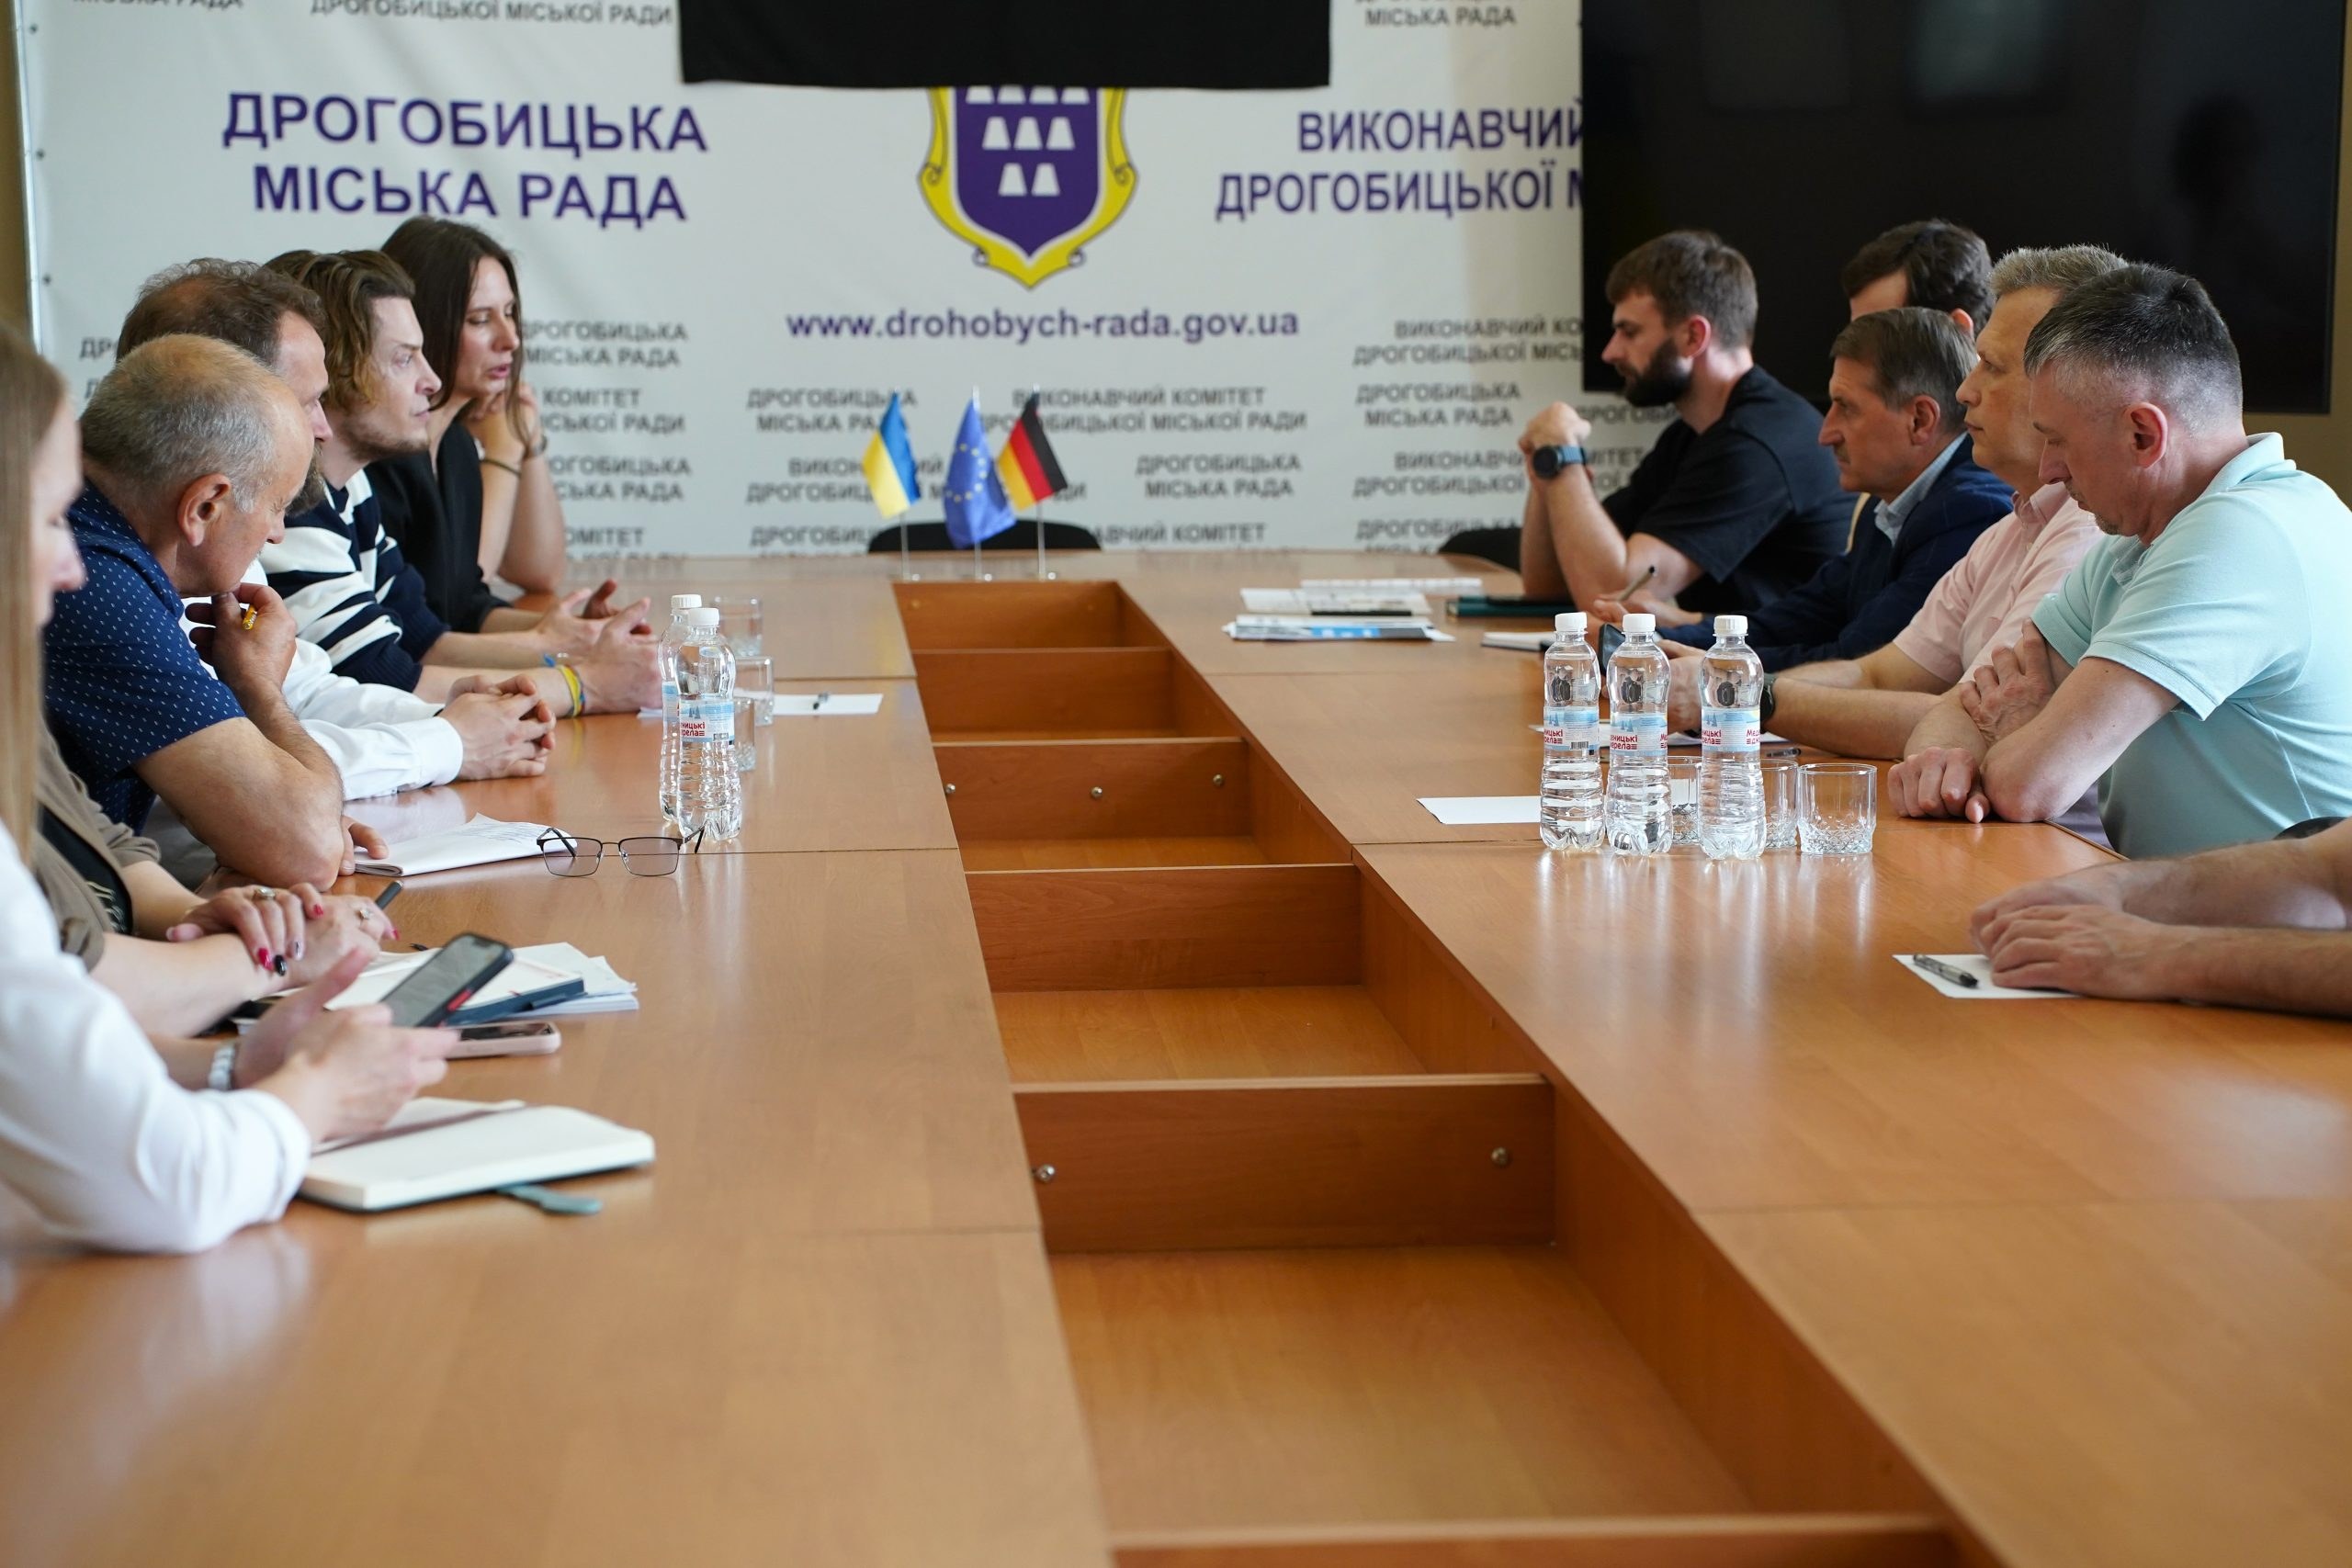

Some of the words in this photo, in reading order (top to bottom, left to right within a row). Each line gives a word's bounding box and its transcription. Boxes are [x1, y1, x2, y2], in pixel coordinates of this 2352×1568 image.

[505, 2, 602, 24] МІСЬКОЇ
[609, 6, 673, 27] РАДИ
[1365, 7, 1450, 27] МІСЬКА
[1455, 6, 1517, 27] РАДА
[223, 93, 707, 158] ДРОГОБИЦЬКА
[254, 164, 497, 218] МІСЬКА
[518, 174, 687, 230] РАДА
[1216, 159, 1558, 220] ДРОГОБИЦЬКОЇ
[786, 309, 1299, 345] www.drohobych-rada.gov.ua
[1395, 314, 1547, 339] ВИКОНАВЧИЙ
[617, 348, 681, 368] РАДА
[1352, 340, 1525, 367] ДРОГОБИЦЬКОЇ
[542, 388, 640, 408] КОМІТЕТ
[746, 389, 917, 410] ДРОГОБИЦЬА
[1012, 387, 1164, 408] ВКОНАВЧИЙ
[1171, 387, 1266, 407] КОМІТЕТ
[1355, 382, 1521, 406] ДРОГОБИЦЬКА
[623, 413, 684, 434] РАДИ
[756, 413, 842, 433] МІСЬКА
[1152, 412, 1242, 433] МІСЬКОЇ
[1248, 412, 1307, 432] РАДИ
[1364, 409, 1448, 428] МІСЬКА
[1453, 406, 1513, 427] РАДА
[1135, 455, 1302, 477] ДРОГОБИЦЬКА
[1395, 449, 1523, 470] ВИКОНАВЧИ
[621, 482, 684, 502] РАДА
[1144, 479, 1229, 499] МІСЬКА
[1234, 479, 1295, 500] РАДА
[1171, 523, 1267, 544] КОМІТЕТ
